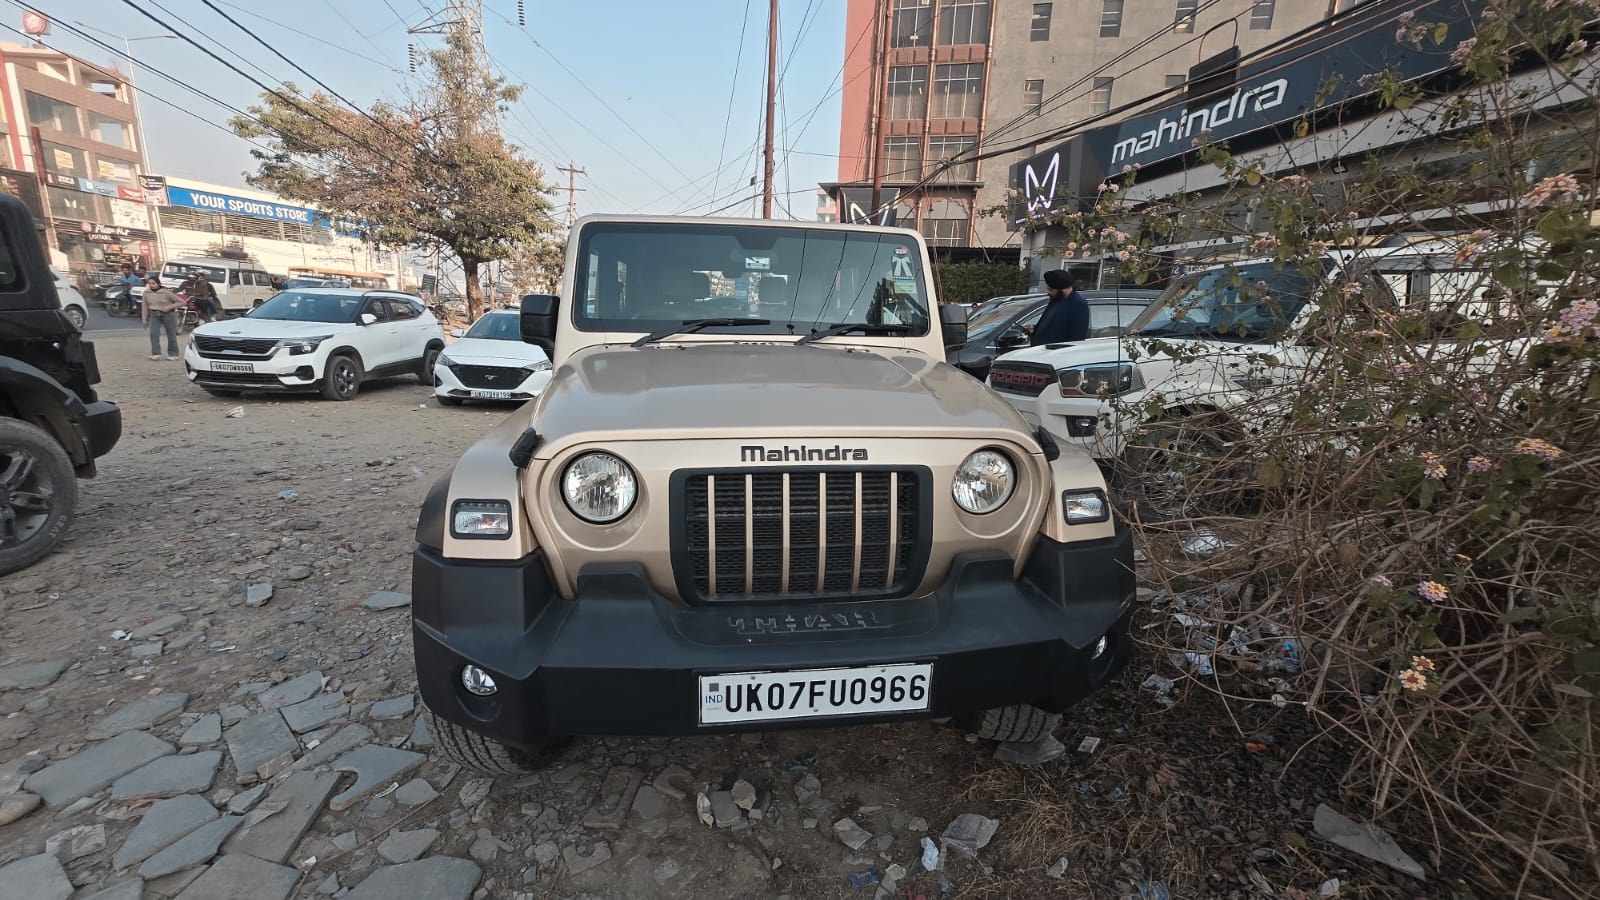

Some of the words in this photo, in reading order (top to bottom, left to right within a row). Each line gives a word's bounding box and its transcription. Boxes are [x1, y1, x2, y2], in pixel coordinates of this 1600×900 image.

[1112, 78, 1289, 165] mahindra
[190, 193, 226, 209] YOUR
[229, 199, 274, 216] SPORTS
[276, 207, 309, 221] STORE
[741, 445, 868, 462] Mahindra
[705, 694, 723, 704] IND
[725, 674, 926, 713] UK07FU0966
